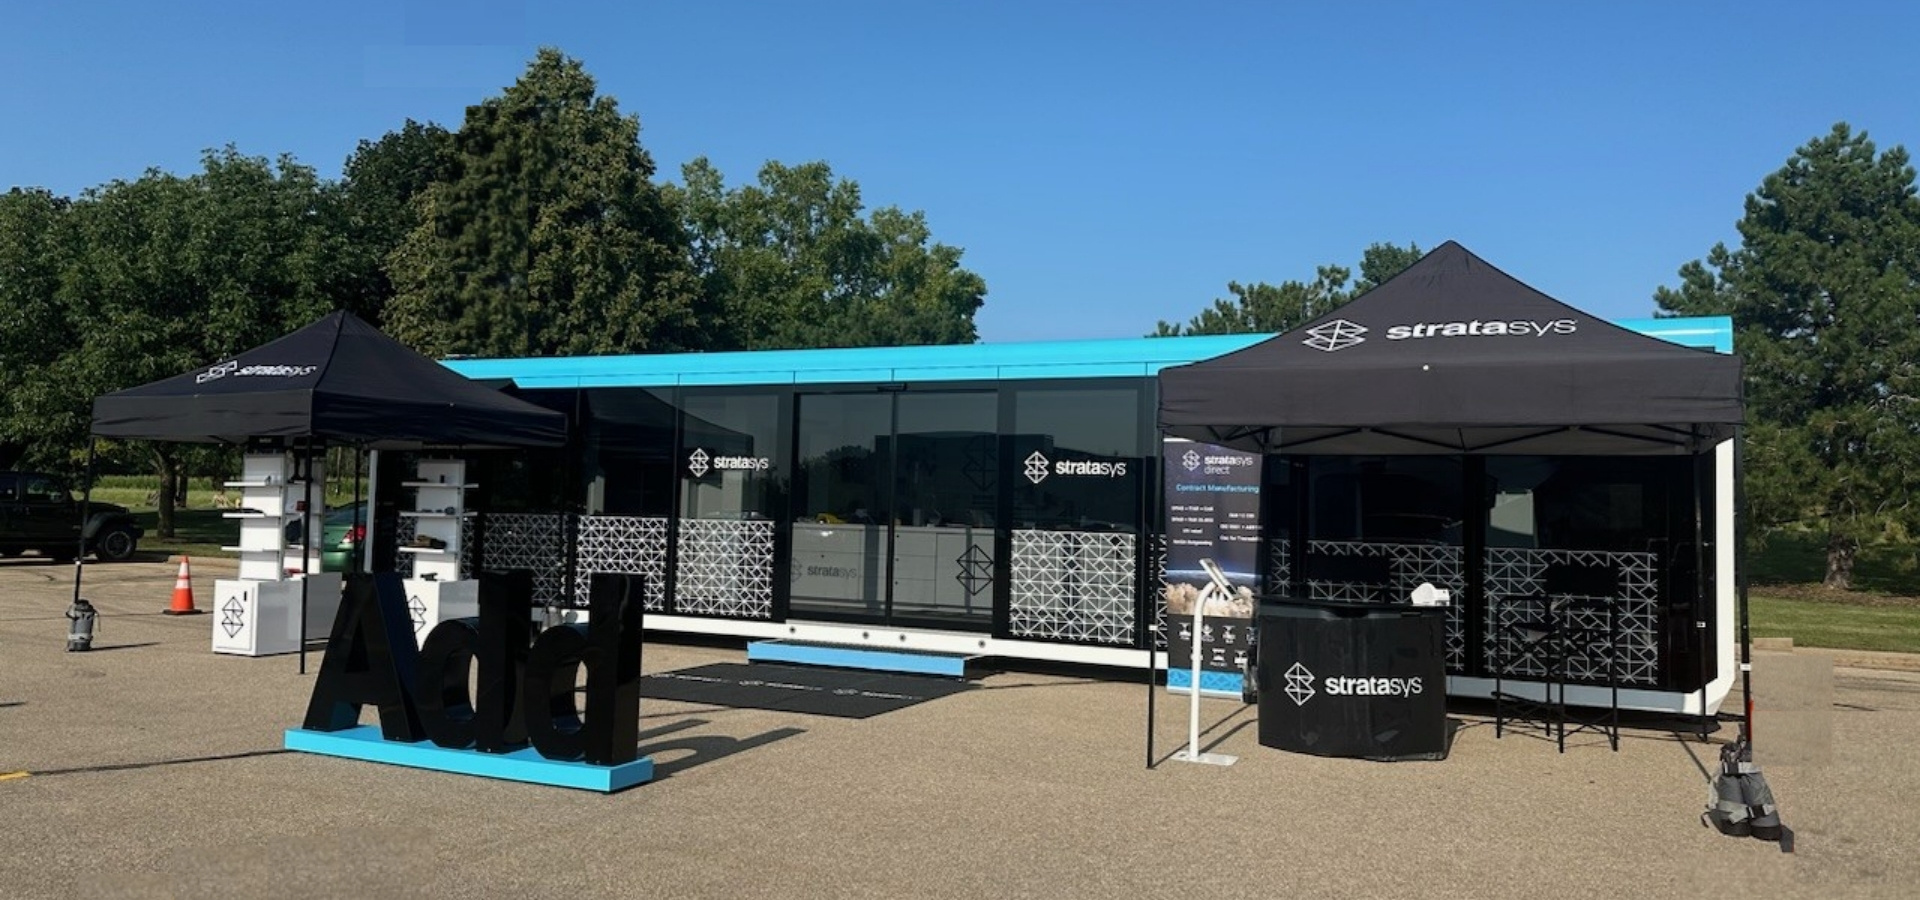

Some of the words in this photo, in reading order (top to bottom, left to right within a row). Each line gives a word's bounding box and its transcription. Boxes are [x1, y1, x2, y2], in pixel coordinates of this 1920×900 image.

[1386, 319, 1577, 339] stratasys
[234, 365, 317, 377] stratasys
[712, 456, 769, 472] stratasys
[1204, 455, 1253, 466] stratasys
[1055, 459, 1126, 478] stratasys
[1204, 466, 1231, 475] direct
[1176, 483, 1206, 492] Contract
[1207, 485, 1260, 494] Manufacturing
[807, 565, 857, 579] stratasys
[302, 569, 643, 766] Add
[1325, 675, 1422, 698] stratasys
